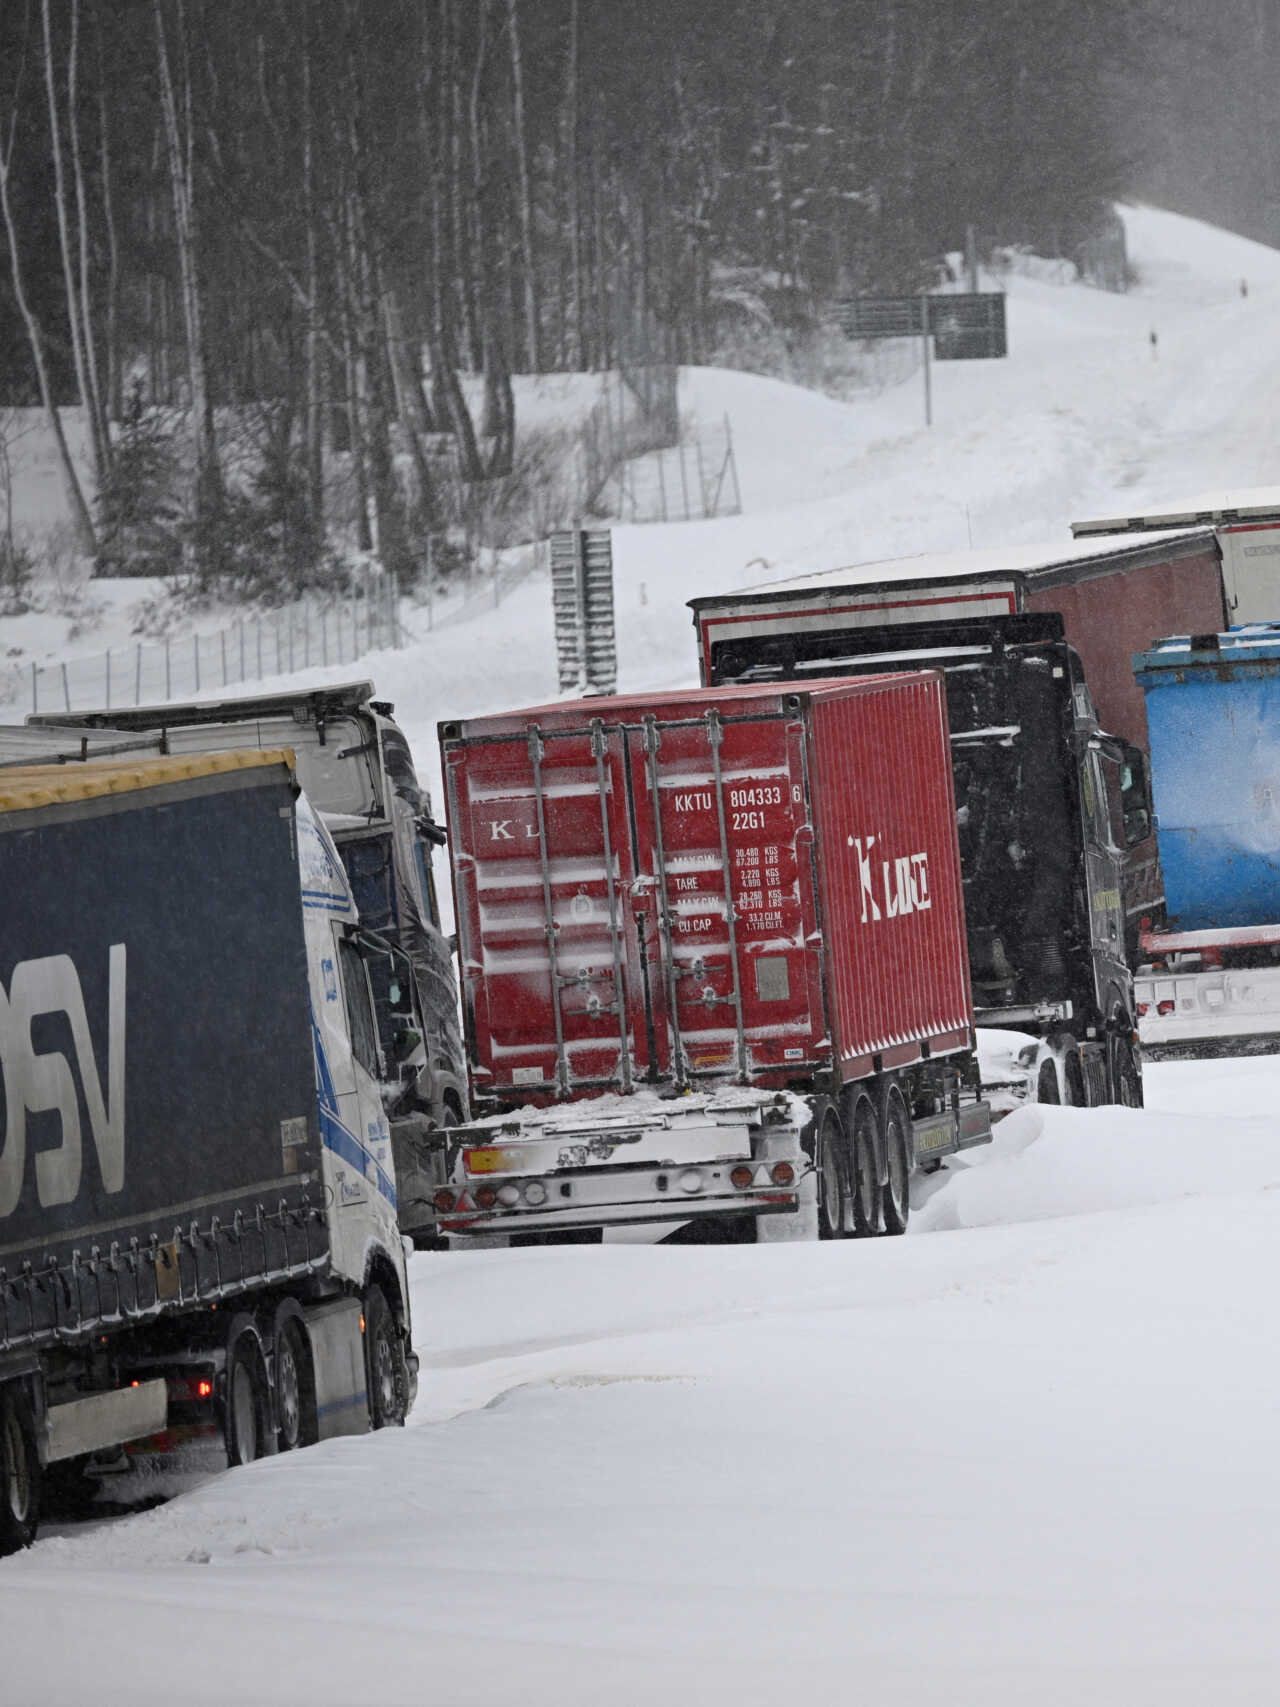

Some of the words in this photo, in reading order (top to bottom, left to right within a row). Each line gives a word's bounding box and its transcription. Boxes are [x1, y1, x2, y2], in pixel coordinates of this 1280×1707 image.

[675, 792, 712, 812] KKTU
[730, 786, 781, 808] 804333
[792, 785, 801, 802] 6
[732, 811, 765, 830] 22G1
[764, 846, 778, 856] KGS
[765, 855, 779, 865] LBS
[675, 877, 698, 890] TARE
[766, 868, 779, 877] KGS
[766, 877, 780, 886] LBS
[882, 852, 932, 919] LINE
[768, 889, 782, 899] KGS
[768, 898, 783, 908] LBS
[678, 921, 691, 933] CU
[693, 919, 712, 932] CAP
